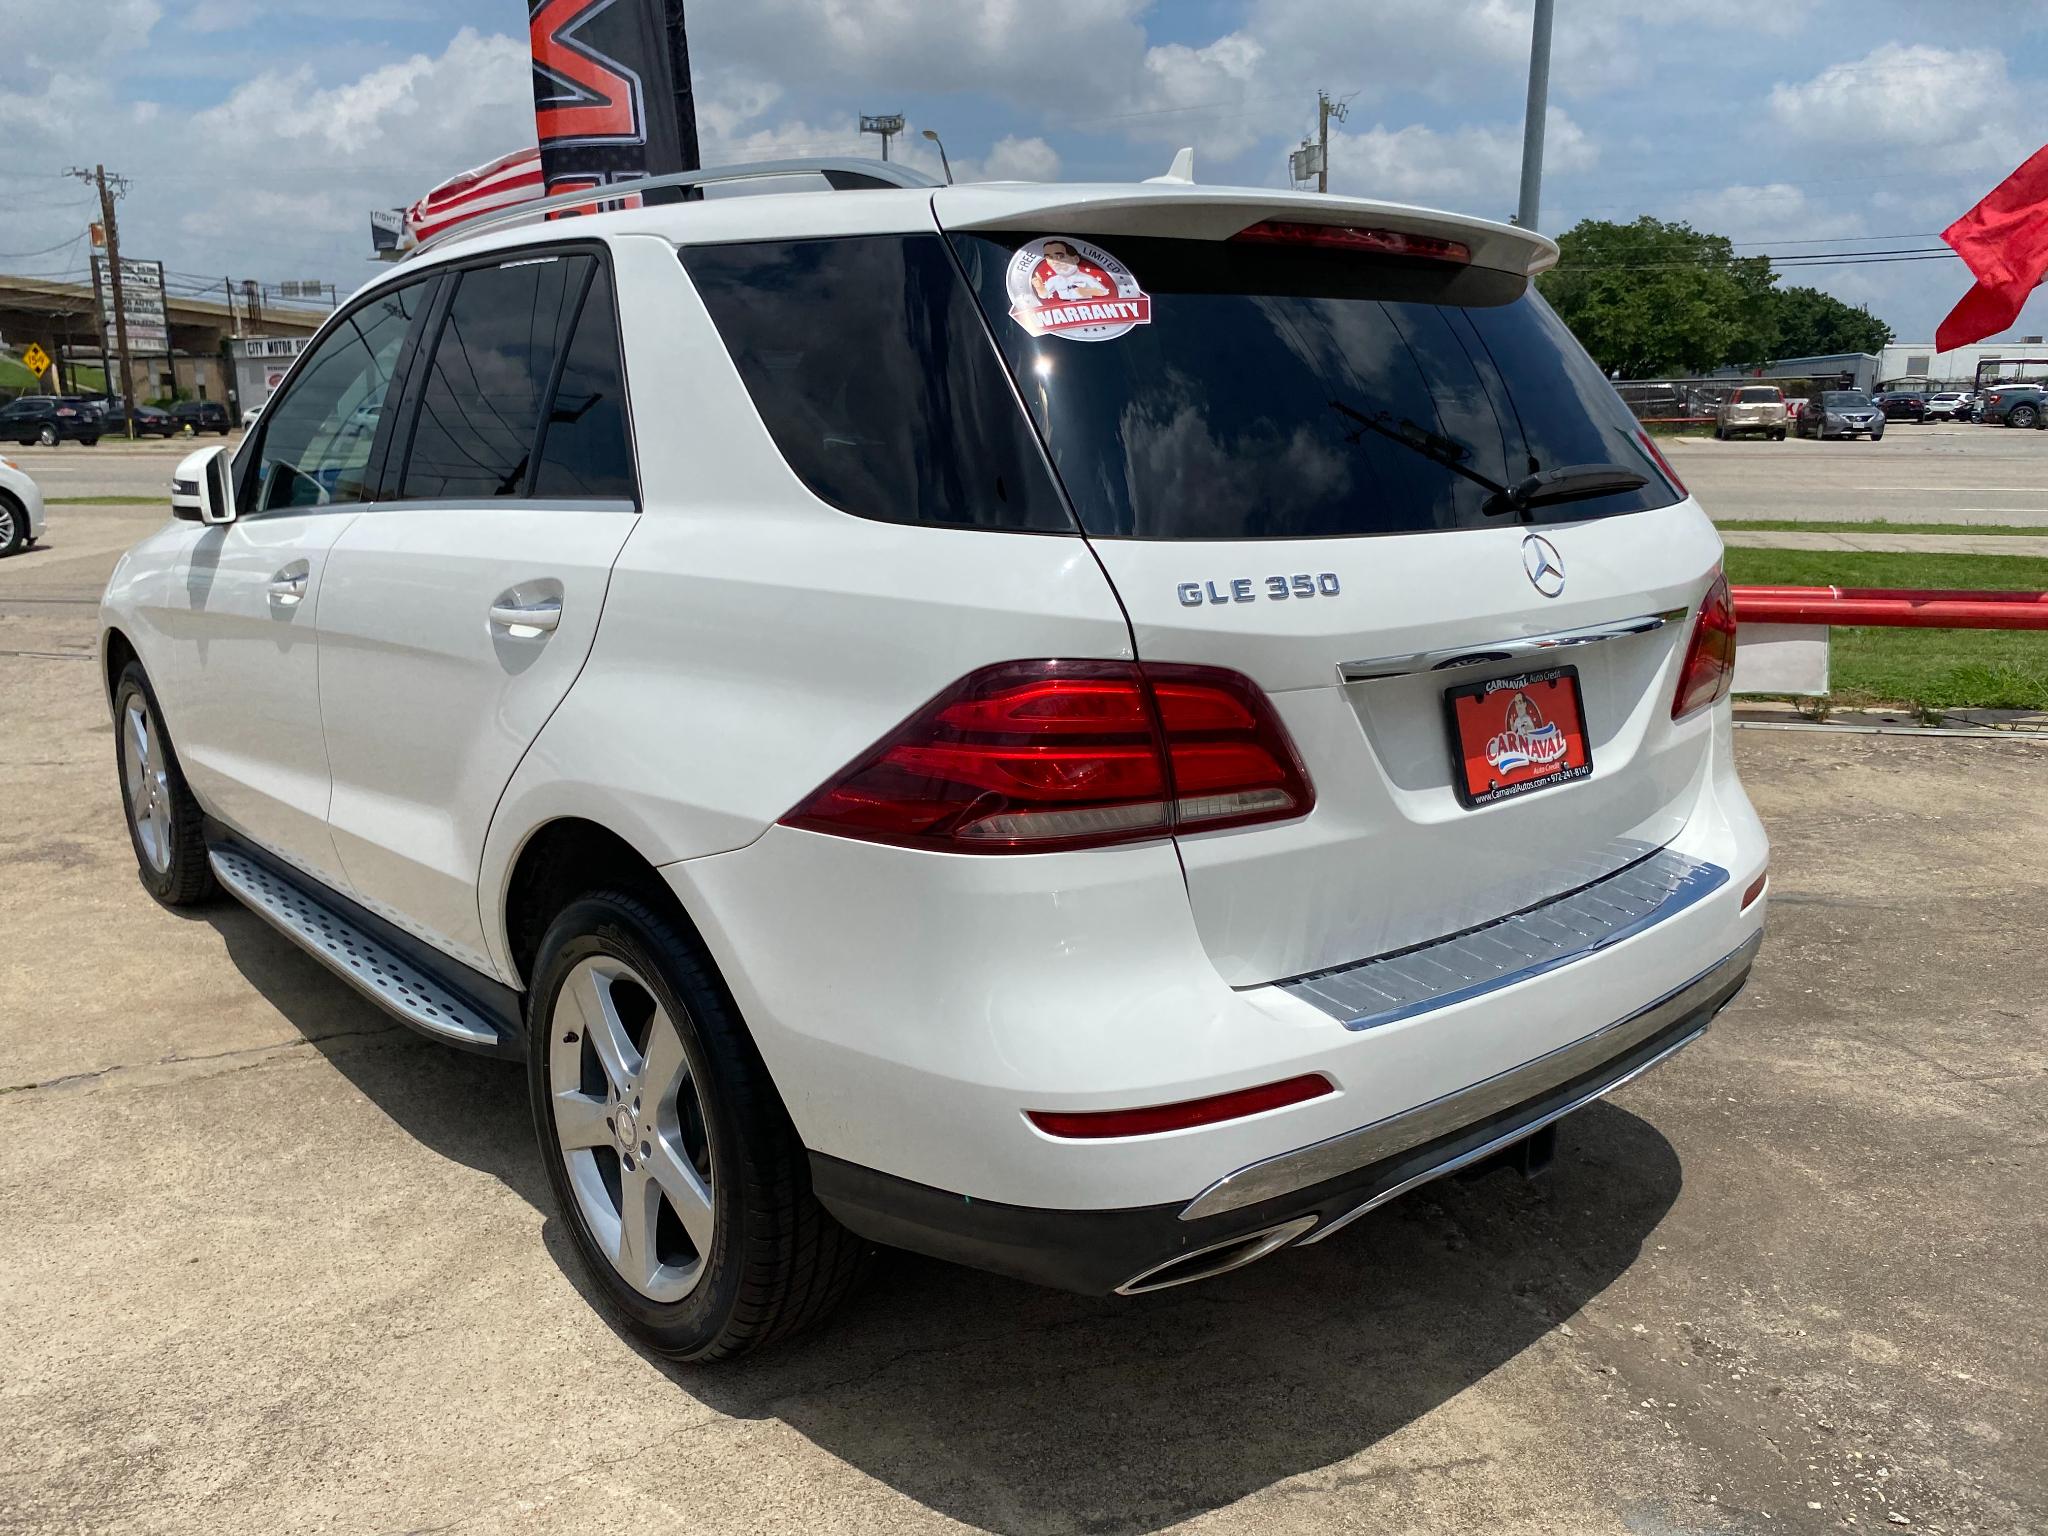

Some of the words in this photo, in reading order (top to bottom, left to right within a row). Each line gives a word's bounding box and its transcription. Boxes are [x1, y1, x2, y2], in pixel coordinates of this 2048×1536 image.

[1017, 251, 1037, 272] FREE
[1082, 247, 1121, 273] LIMITED
[1034, 302, 1140, 327] WARRANTY
[247, 341, 263, 354] CITY
[267, 340, 291, 353] MOTOR
[1177, 579, 1256, 607] GLE
[1265, 573, 1340, 601] 350
[1485, 677, 1529, 692] CARNAVAL
[1530, 674, 1544, 683] Auto
[1487, 730, 1565, 763] CARNAVAL
